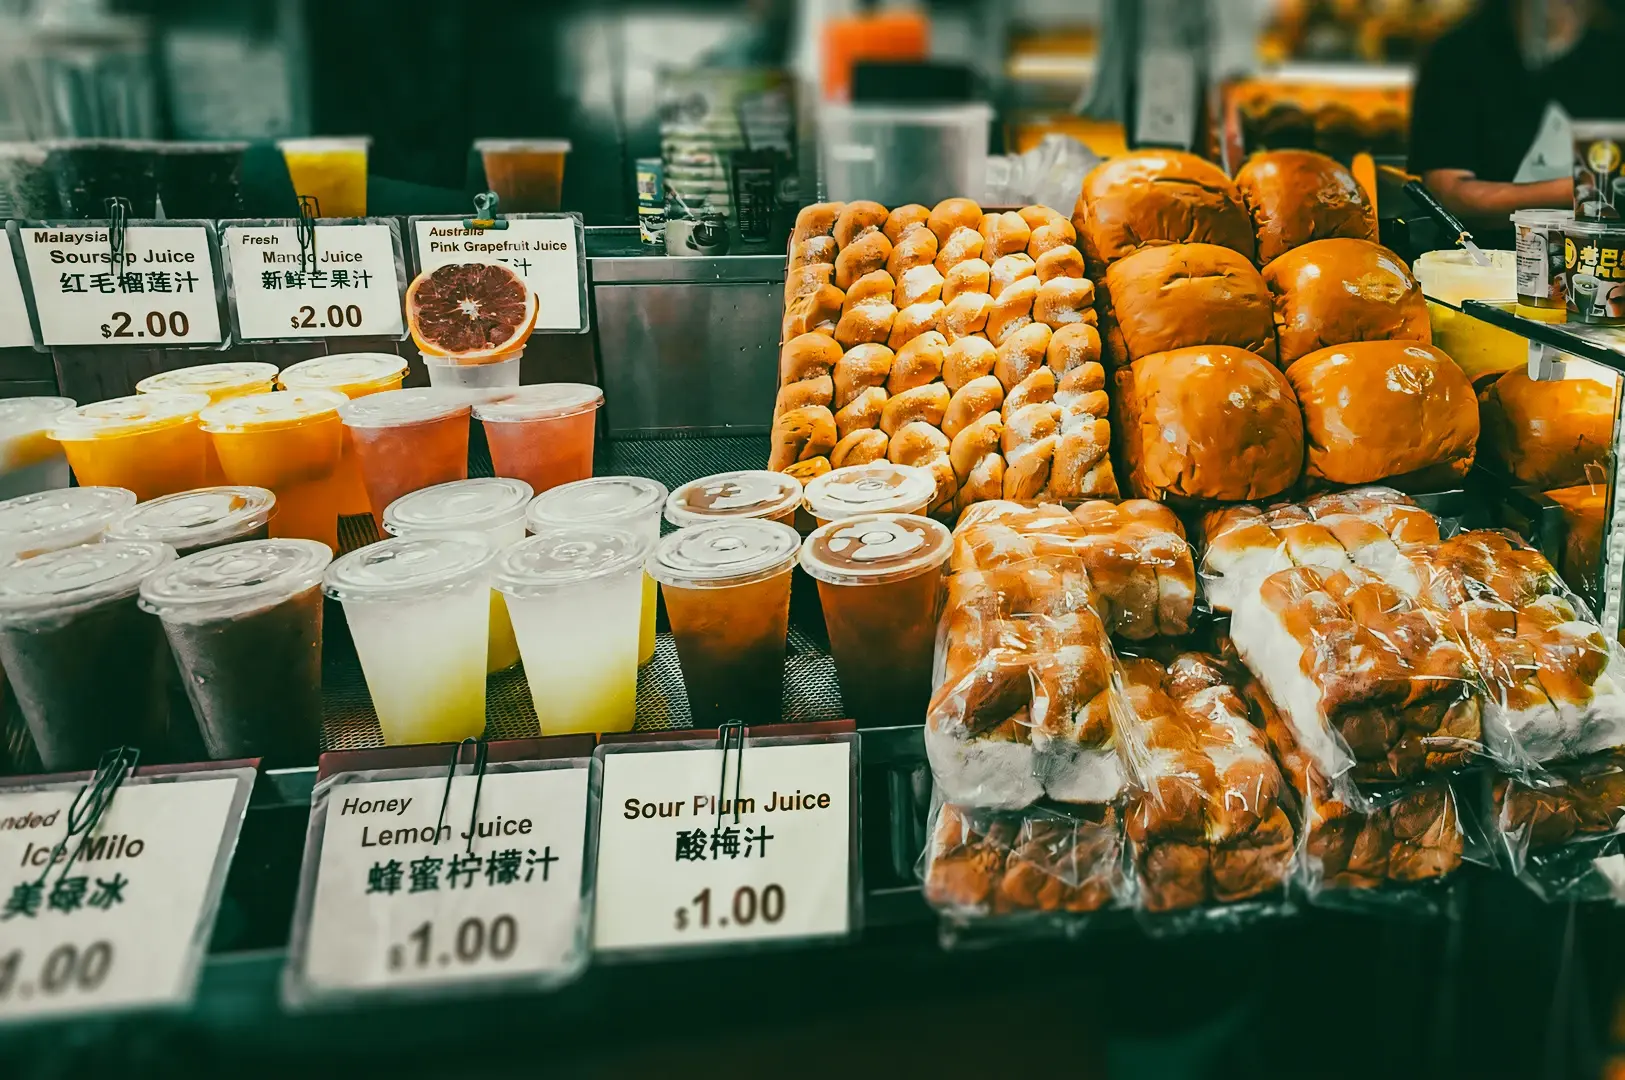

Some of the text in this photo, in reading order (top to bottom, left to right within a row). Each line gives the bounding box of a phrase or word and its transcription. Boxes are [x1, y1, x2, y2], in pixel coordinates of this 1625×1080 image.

[34, 232, 108, 245] Malaysia
[242, 234, 279, 245] Fresh
[429, 227, 485, 237] Australia
[50, 249, 195, 267] Soursop Juice
[263, 250, 363, 266] Mango Juice
[430, 240, 568, 254] Pink Grapefruit Juice
[60, 271, 199, 294] 红毛榴莲汁
[261, 269, 373, 290] 新鲜芒果汁
[101, 311, 189, 339] $2.00
[290, 304, 363, 330] $2.00
[341, 796, 412, 815] Honey
[624, 789, 831, 820] Sour Plum Juice
[361, 815, 533, 848] Lemon Juice
[675, 825, 774, 862] 酸梅汁
[20, 834, 145, 868] Ice Milo
[364, 846, 560, 896] 蜂蜜柠檬汁
[674, 883, 786, 932] $1.00
[387, 913, 518, 972] $1.00
